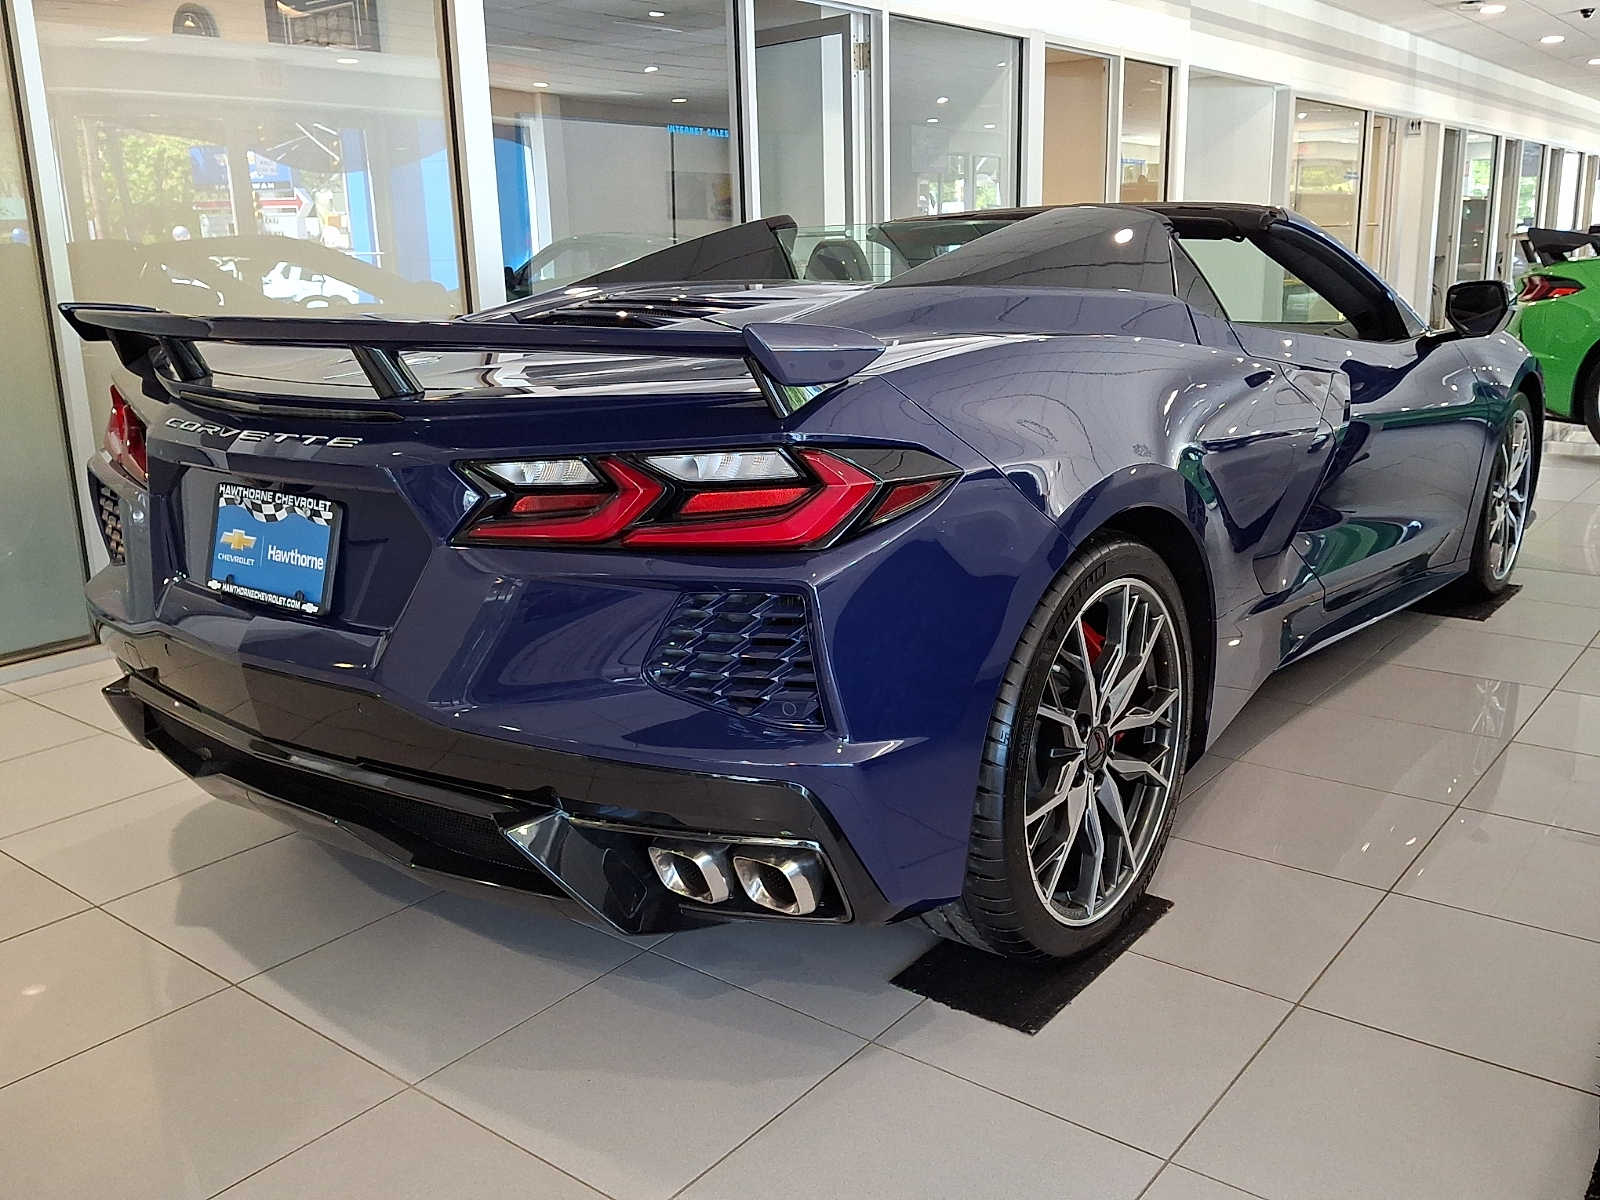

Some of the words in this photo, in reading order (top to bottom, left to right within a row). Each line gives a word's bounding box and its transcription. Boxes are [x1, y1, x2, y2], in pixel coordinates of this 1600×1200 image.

[667, 124, 703, 135] INTERNET
[706, 128, 729, 138] SALES
[165, 417, 363, 448] CORVETTE
[219, 484, 273, 502] HAWTHORNE
[275, 493, 332, 511] CHEVROLET
[217, 552, 255, 566] CHEVROLET
[267, 544, 324, 570] Hawthorne
[222, 582, 301, 609] HAWTHORNECHEVROLET.COM
